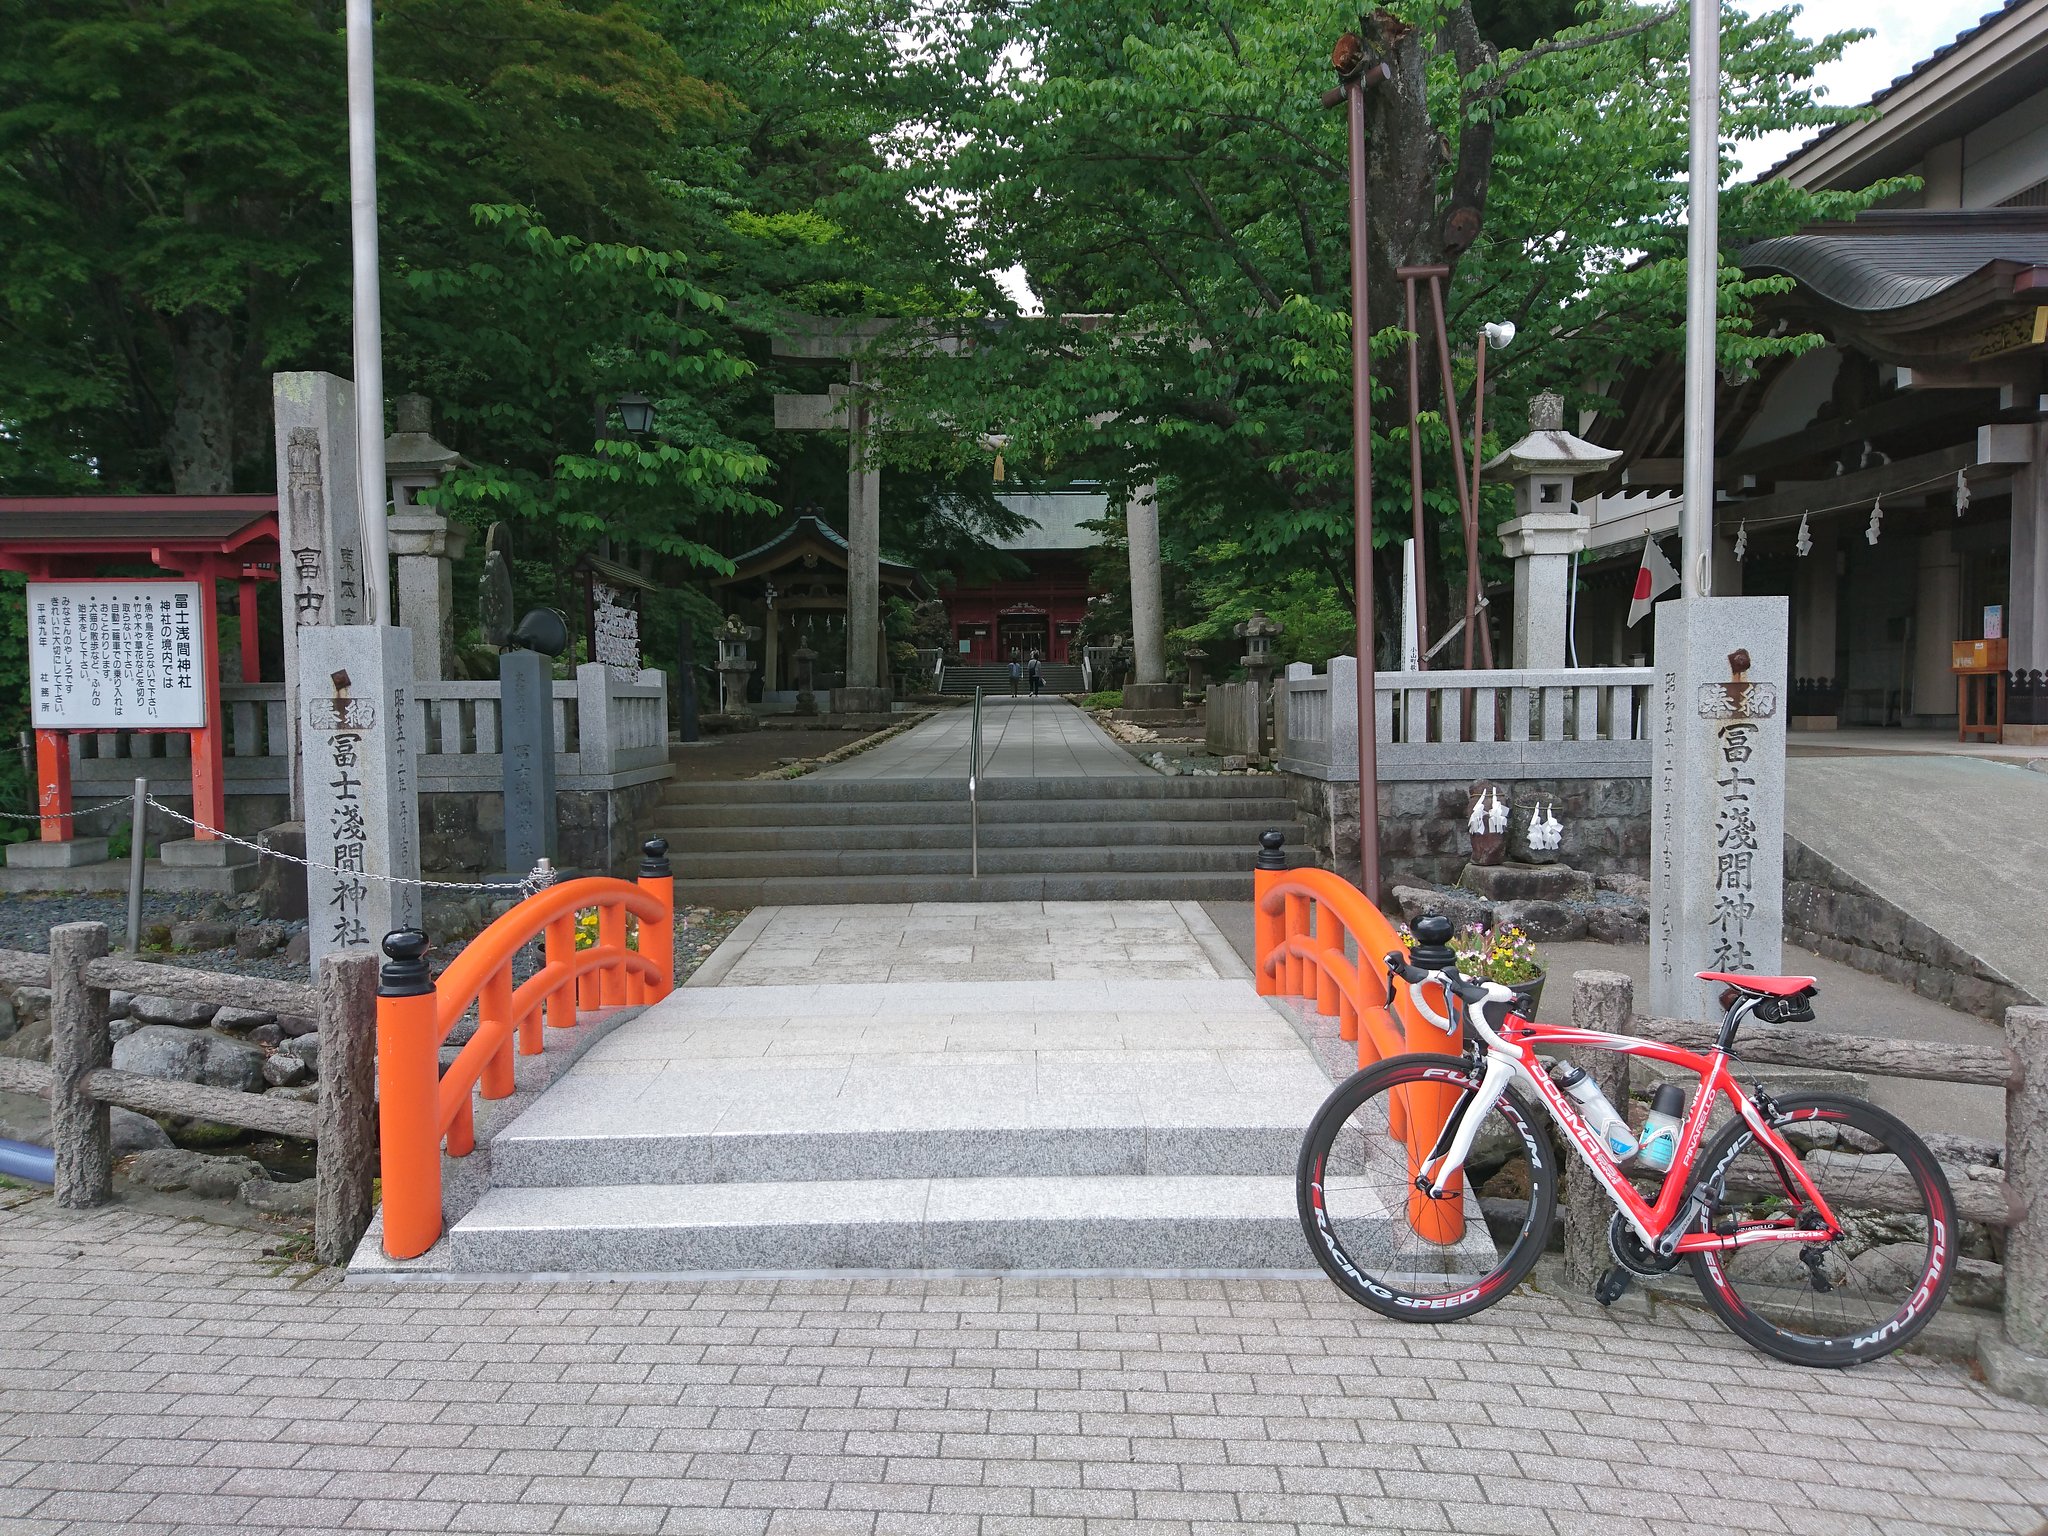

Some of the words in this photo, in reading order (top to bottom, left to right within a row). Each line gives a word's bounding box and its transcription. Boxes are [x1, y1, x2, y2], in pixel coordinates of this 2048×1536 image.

[37, 603, 48, 647] 平成九年
[292, 547, 324, 625] 富士
[50, 597, 65, 716] きれいに大切にして下さい。
[61, 596, 73, 694] みなさんのやしろです
[77, 603, 91, 682] 始末をして下さい。
[89, 603, 101, 707] 犬猫の散歩など、ふんの
[100, 603, 113, 682] おことわりします。
[111, 603, 123, 716] 自動二輪車での乗り入れは
[122, 603, 135, 682] 取らないで下さい。
[133, 603, 145, 707] 竹や木や草花などを切り
[144, 603, 158, 718] 魚や鳥をとらないで下さい。
[159, 600, 174, 689] 神社の境内では
[40, 673, 50, 712] 社務所
[1532, 1064, 1599, 1158] DOGMA
[1683, 1088, 1716, 1167] PINARELLO
[1314, 1209, 1393, 1299] RACING
[1394, 1289, 1480, 1309] SPEED
